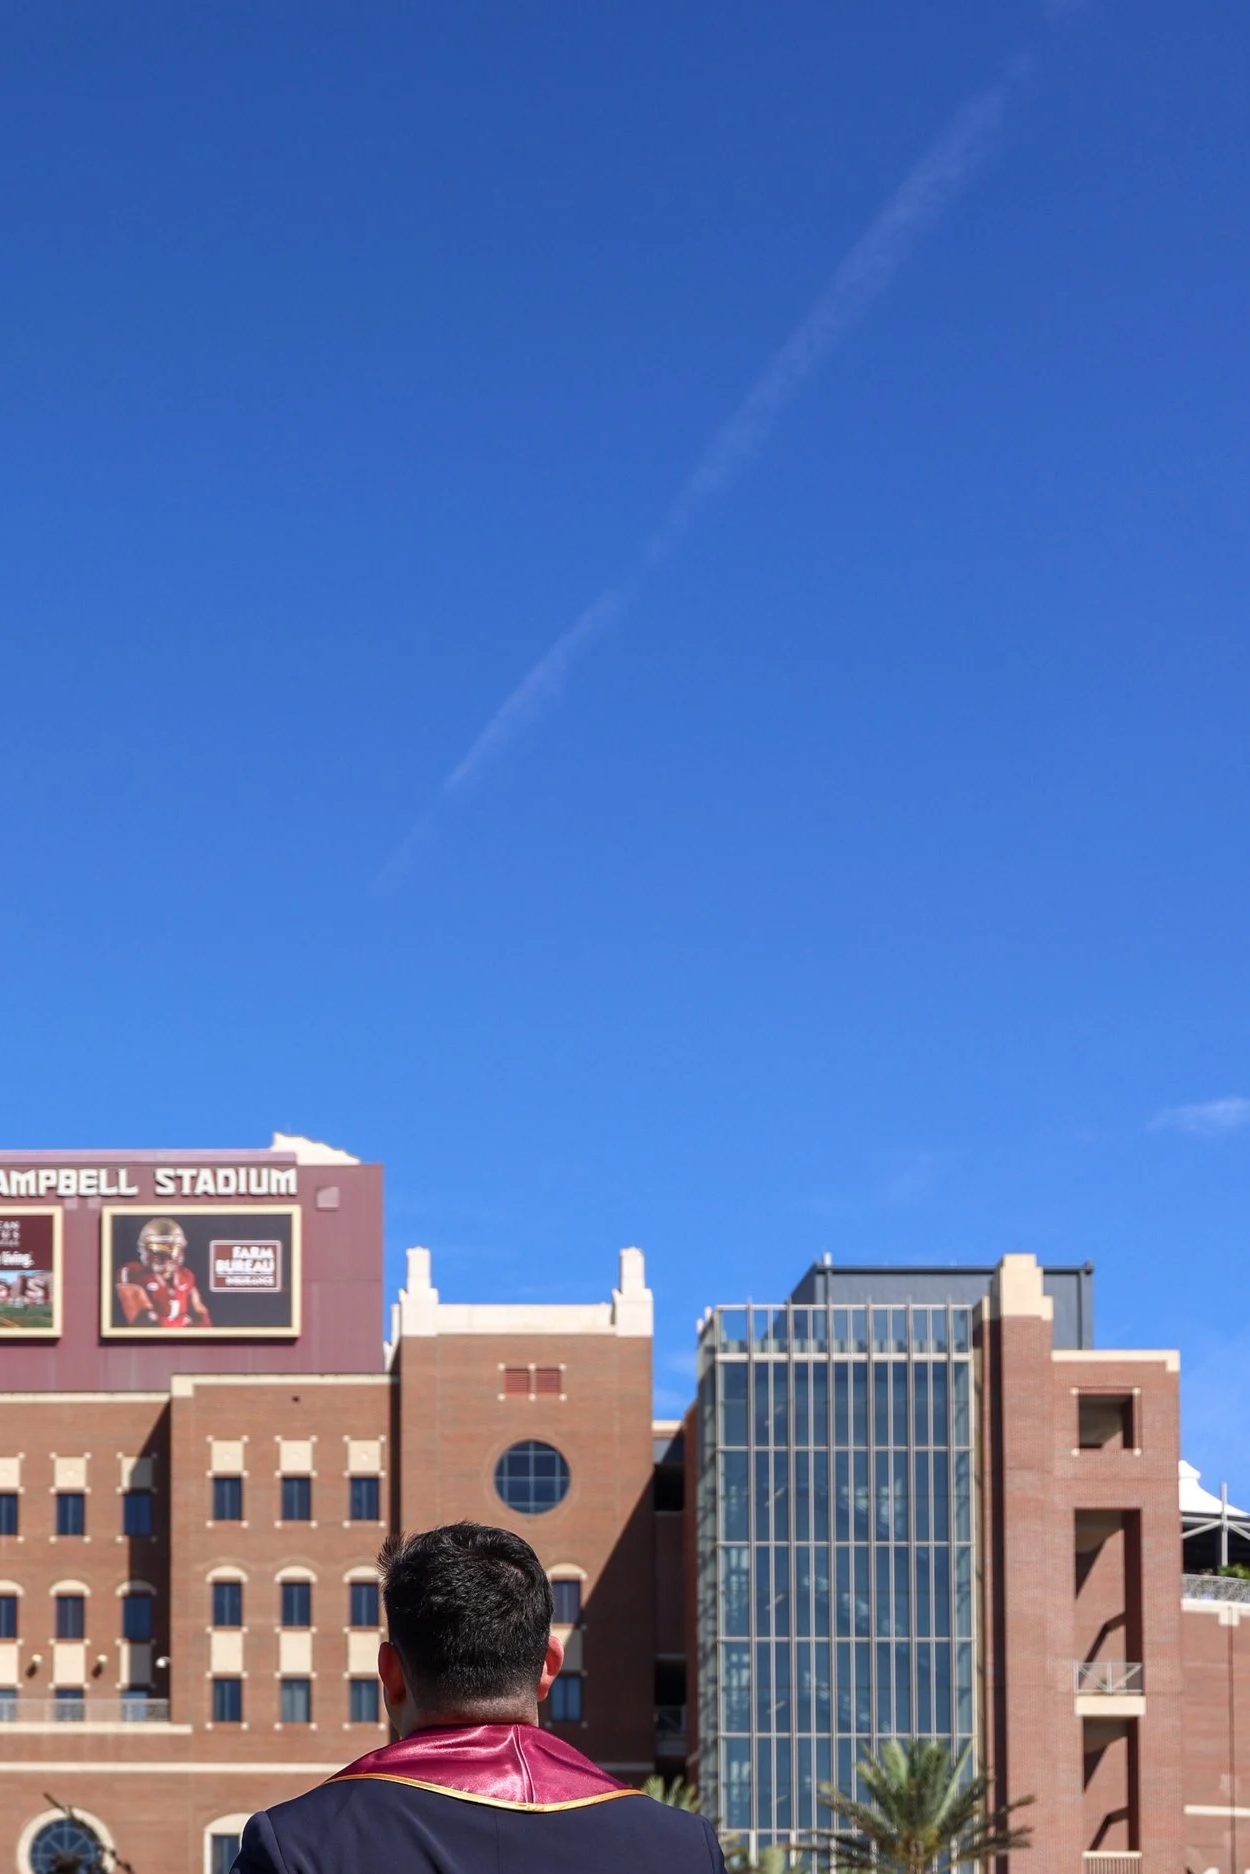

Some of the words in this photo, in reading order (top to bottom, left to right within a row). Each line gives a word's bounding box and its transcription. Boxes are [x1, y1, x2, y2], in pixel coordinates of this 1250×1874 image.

[154, 1167, 298, 1196] STADIUM
[232, 1246, 274, 1259] FARM
[215, 1259, 275, 1274] BUREAU
